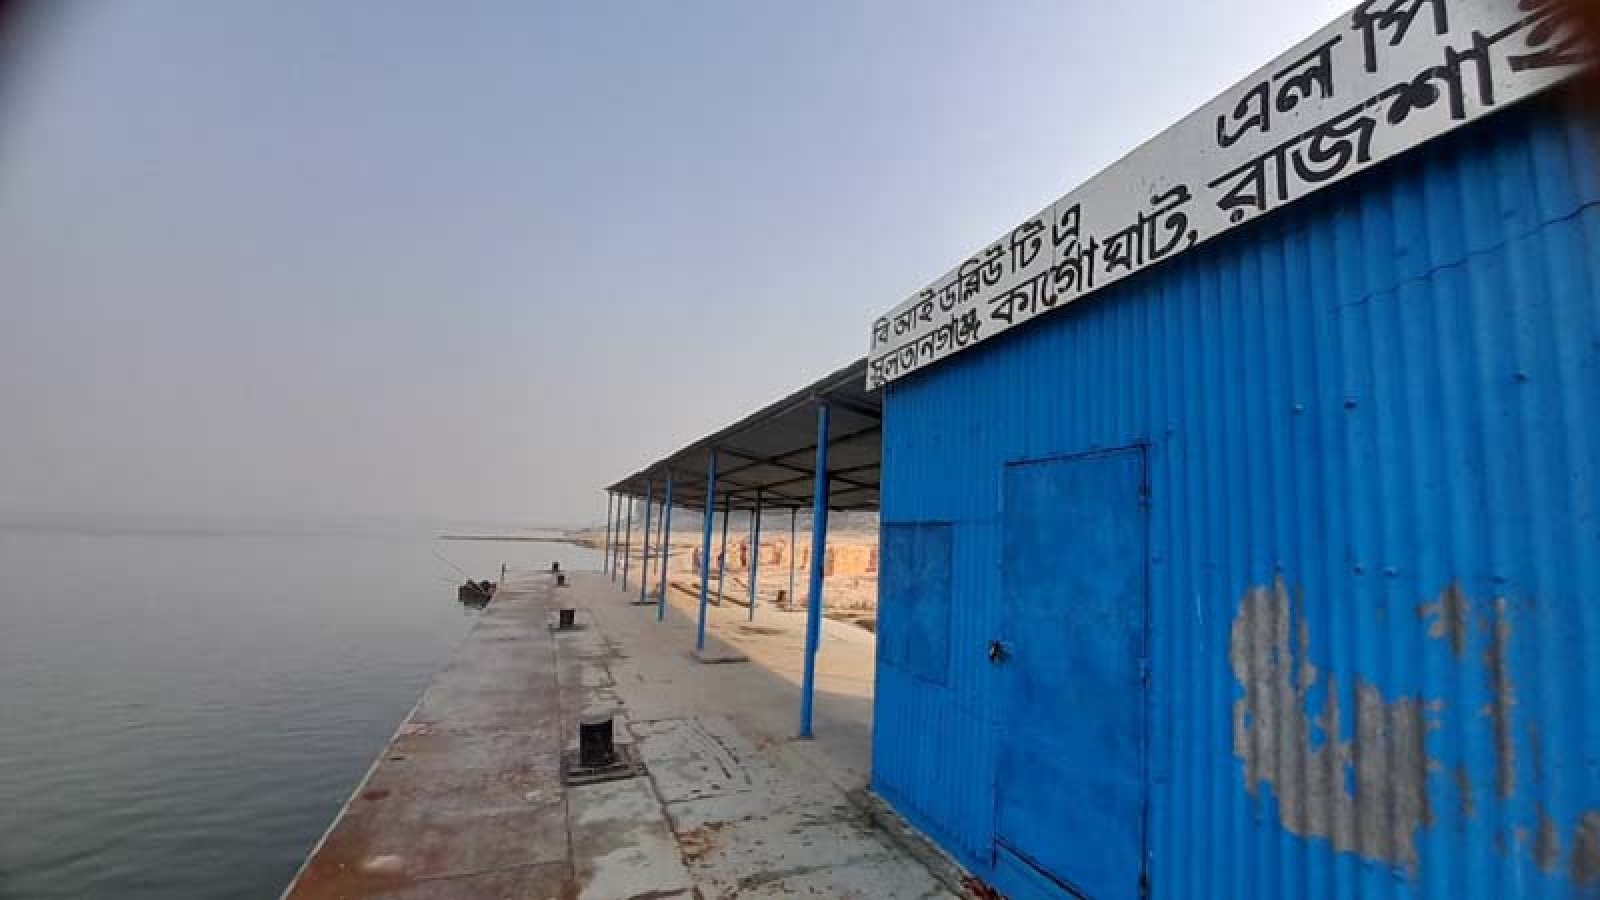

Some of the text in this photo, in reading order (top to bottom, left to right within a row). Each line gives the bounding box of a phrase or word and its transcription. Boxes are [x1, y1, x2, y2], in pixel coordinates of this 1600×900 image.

[869, 307, 982, 387] সুলতানগঞ্জ
[987, 235, 1100, 325] কার্গো
[1101, 184, 1198, 273] ঘাট,
[872, 317, 890, 350] বি
[893, 289, 936, 336] আই
[1008, 219, 1046, 273] টি
[1052, 203, 1081, 246] এ
[1218, 34, 1342, 147] এল
